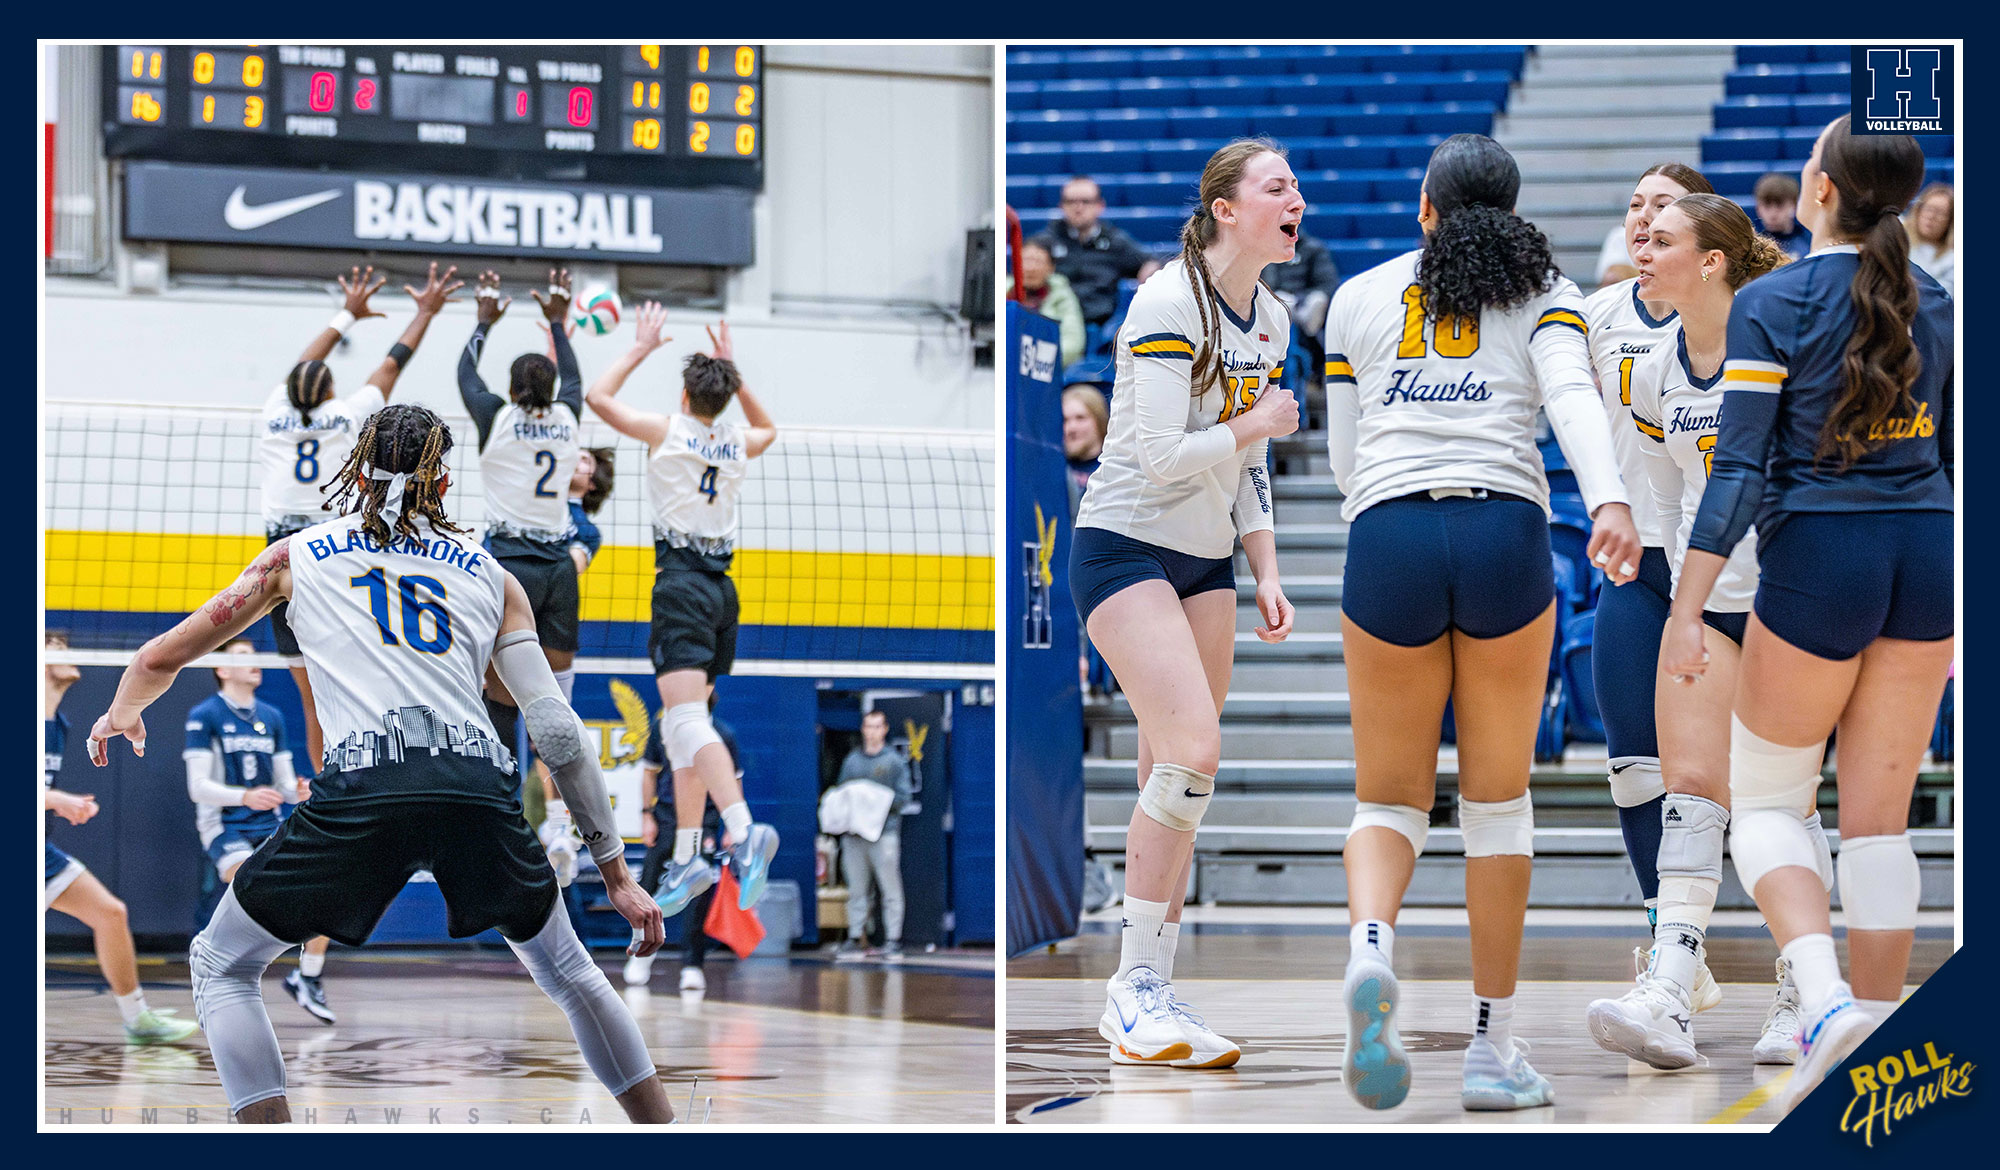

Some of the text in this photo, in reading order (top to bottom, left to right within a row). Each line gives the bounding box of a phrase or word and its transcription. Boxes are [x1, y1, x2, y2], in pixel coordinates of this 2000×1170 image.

[132, 51, 162, 79] 11
[309, 71, 337, 113] 0
[567, 86, 593, 128] 0
[632, 81, 661, 110] 11
[689, 82, 711, 114] 0
[285, 114, 338, 138] POINTS
[545, 129, 596, 152] POINTS
[632, 118, 661, 150] 10
[735, 124, 756, 156] 0
[353, 180, 663, 253] BASKETBALL
[1383, 369, 1493, 407] Hawks
[513, 422, 572, 443] FRANCIS
[294, 438, 320, 483] 8
[534, 449, 558, 498] 2
[698, 464, 720, 505] 4
[349, 566, 455, 657] 16
